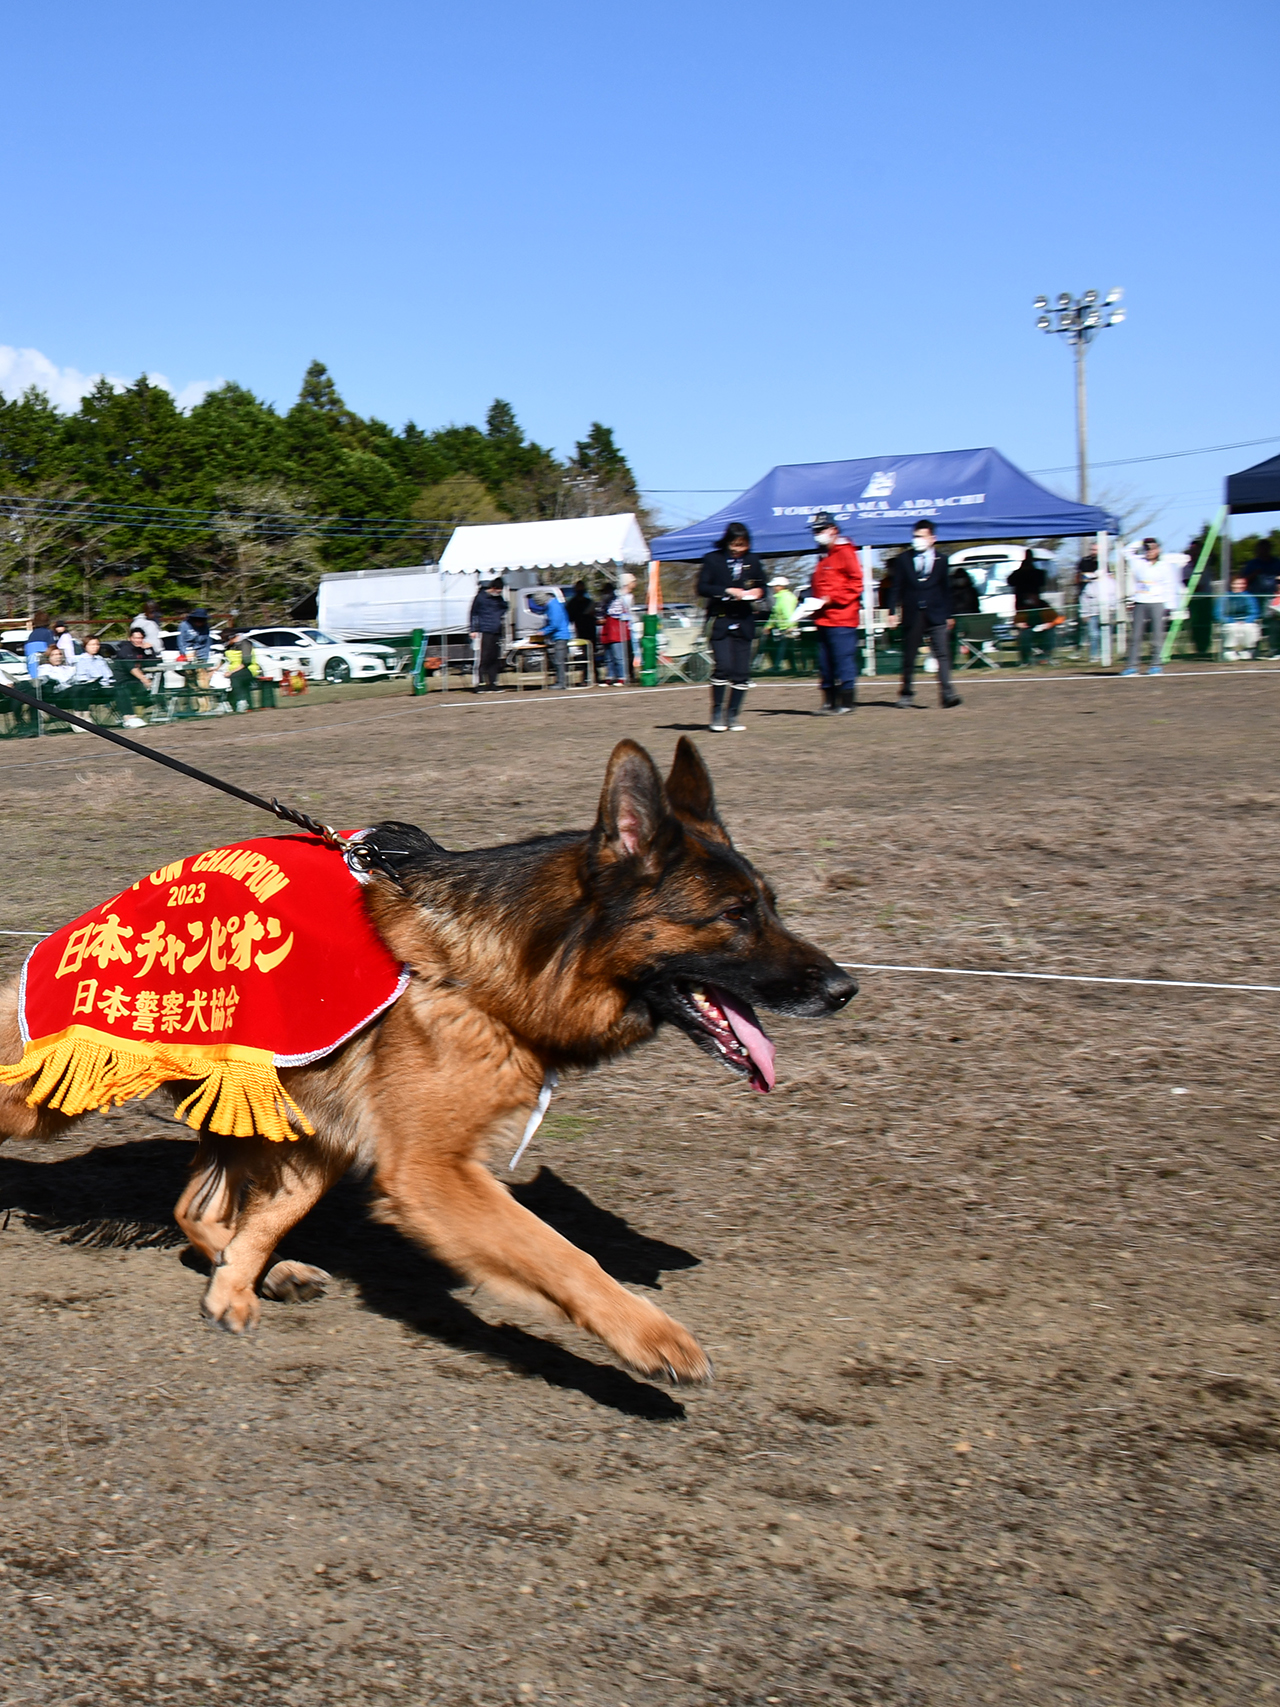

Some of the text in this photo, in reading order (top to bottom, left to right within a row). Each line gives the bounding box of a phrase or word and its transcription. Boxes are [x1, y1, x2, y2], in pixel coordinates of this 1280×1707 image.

[771, 493, 987, 517] YOKOHAMA ADACHI
[857, 508, 942, 519] SCHOOL
[166, 882, 207, 907] 2023
[191, 849, 291, 904] CHAMPION
[54, 910, 294, 979] 日本チャンピオン
[72, 978, 240, 1034] 日本警察犬協会
